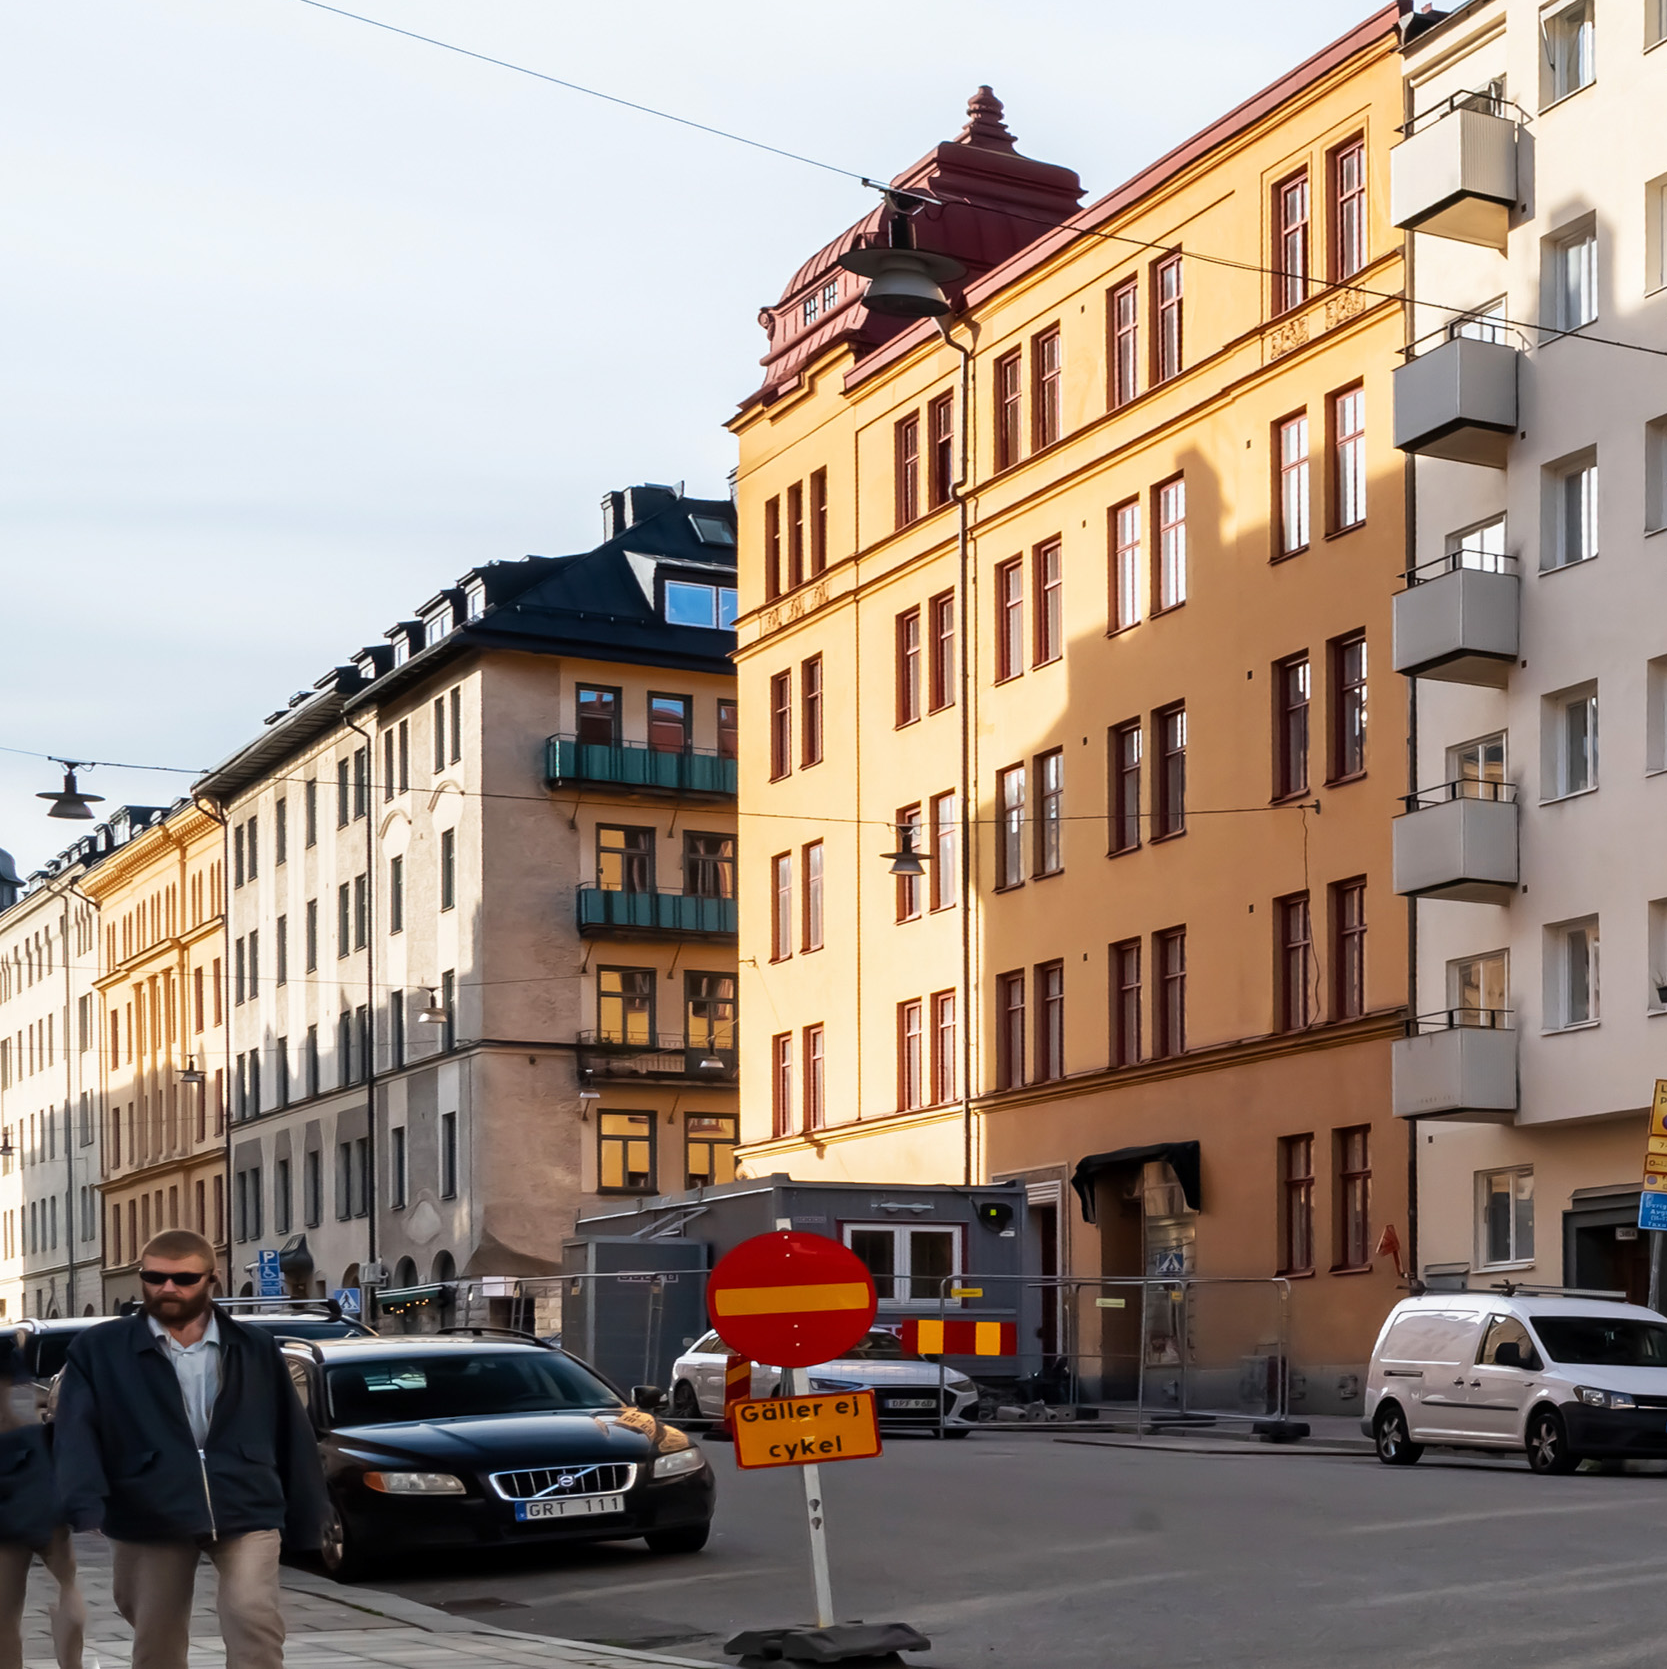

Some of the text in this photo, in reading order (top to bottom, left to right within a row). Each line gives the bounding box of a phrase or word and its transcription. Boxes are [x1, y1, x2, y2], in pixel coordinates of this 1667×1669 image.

[263, 1251, 275, 1263] P
[740, 1396, 859, 1423] Gäller ej
[769, 1435, 842, 1460] cykel
[529, 1497, 618, 1517] GRT 111
